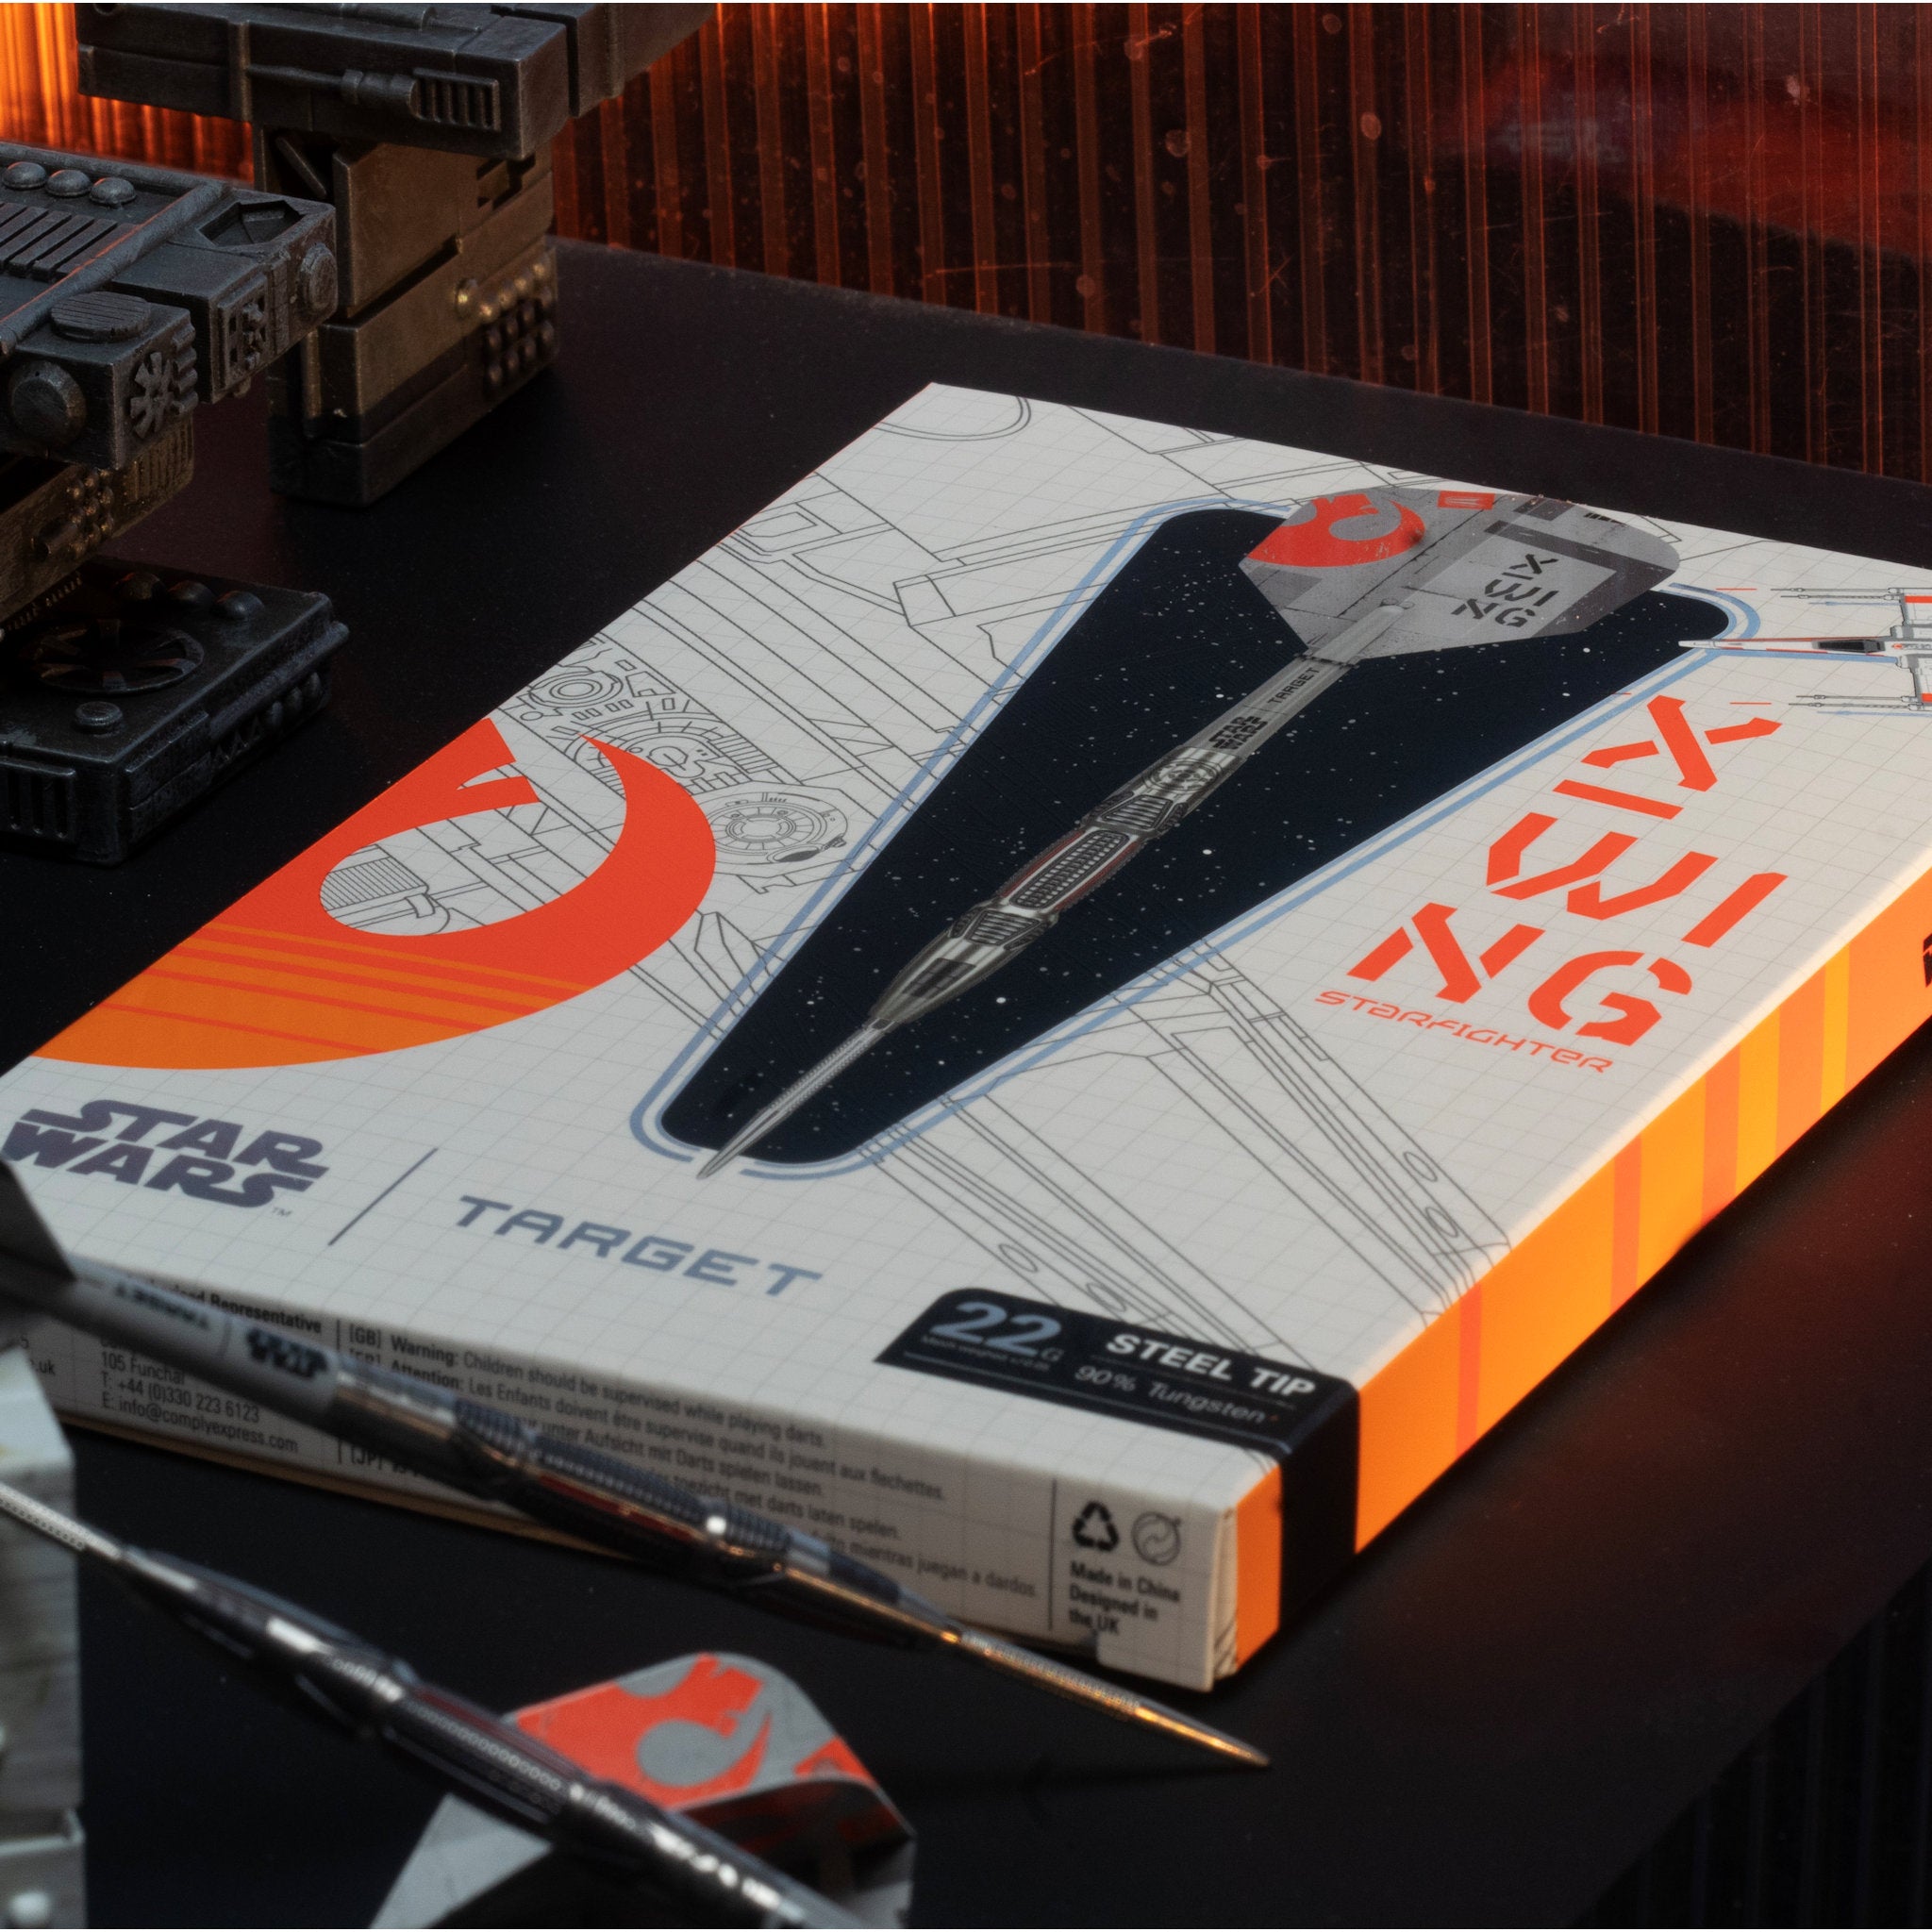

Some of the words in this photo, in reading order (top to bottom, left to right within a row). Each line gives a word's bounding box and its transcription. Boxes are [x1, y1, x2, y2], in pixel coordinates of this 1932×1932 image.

[1267, 667, 1320, 704] TARGET
[1208, 716, 1255, 743] STAR
[1212, 718, 1268, 750] WARS
[0, 1121, 314, 1208] WARS
[21, 1099, 330, 1179] STAR
[456, 1194, 823, 1297] TARGET
[101, 1350, 125, 1372] 105
[130, 1355, 186, 1386] Funchal
[391, 1334, 459, 1367] Warning:
[463, 1350, 525, 1380] Children
[528, 1367, 576, 1391] should
[579, 1376, 598, 1395] be
[601, 1385, 680, 1413] supervised
[685, 1403, 725, 1424] while
[727, 1414, 782, 1441] playing
[1106, 1333, 1232, 1381] STEEL
[1249, 1367, 1317, 1397] TIP
[101, 1371, 113, 1390] T:
[117, 1377, 144, 1395] +44
[147, 1382, 192, 1407] (0)330
[195, 1392, 222, 1415] 223
[225, 1399, 260, 1424] 6123
[391, 1358, 463, 1390] Attention:
[469, 1381, 493, 1397] Les
[497, 1383, 552, 1408] Enfants
[555, 1398, 608, 1422] doivent
[718, 1436, 766, 1459] quand
[1074, 1366, 1136, 1392] 90%
[1147, 1380, 1266, 1424] Tungsten
[101, 1391, 114, 1409] E:
[119, 1395, 299, 1453] info@complyexpress.com
[675, 1448, 715, 1473] Darts
[1069, 1559, 1113, 1586] Made
[1118, 1572, 1132, 1591] in
[1137, 1575, 1181, 1603] China
[1069, 1582, 1141, 1617] Designed
[1142, 1605, 1158, 1622] in
[1096, 1612, 1121, 1635] UK
